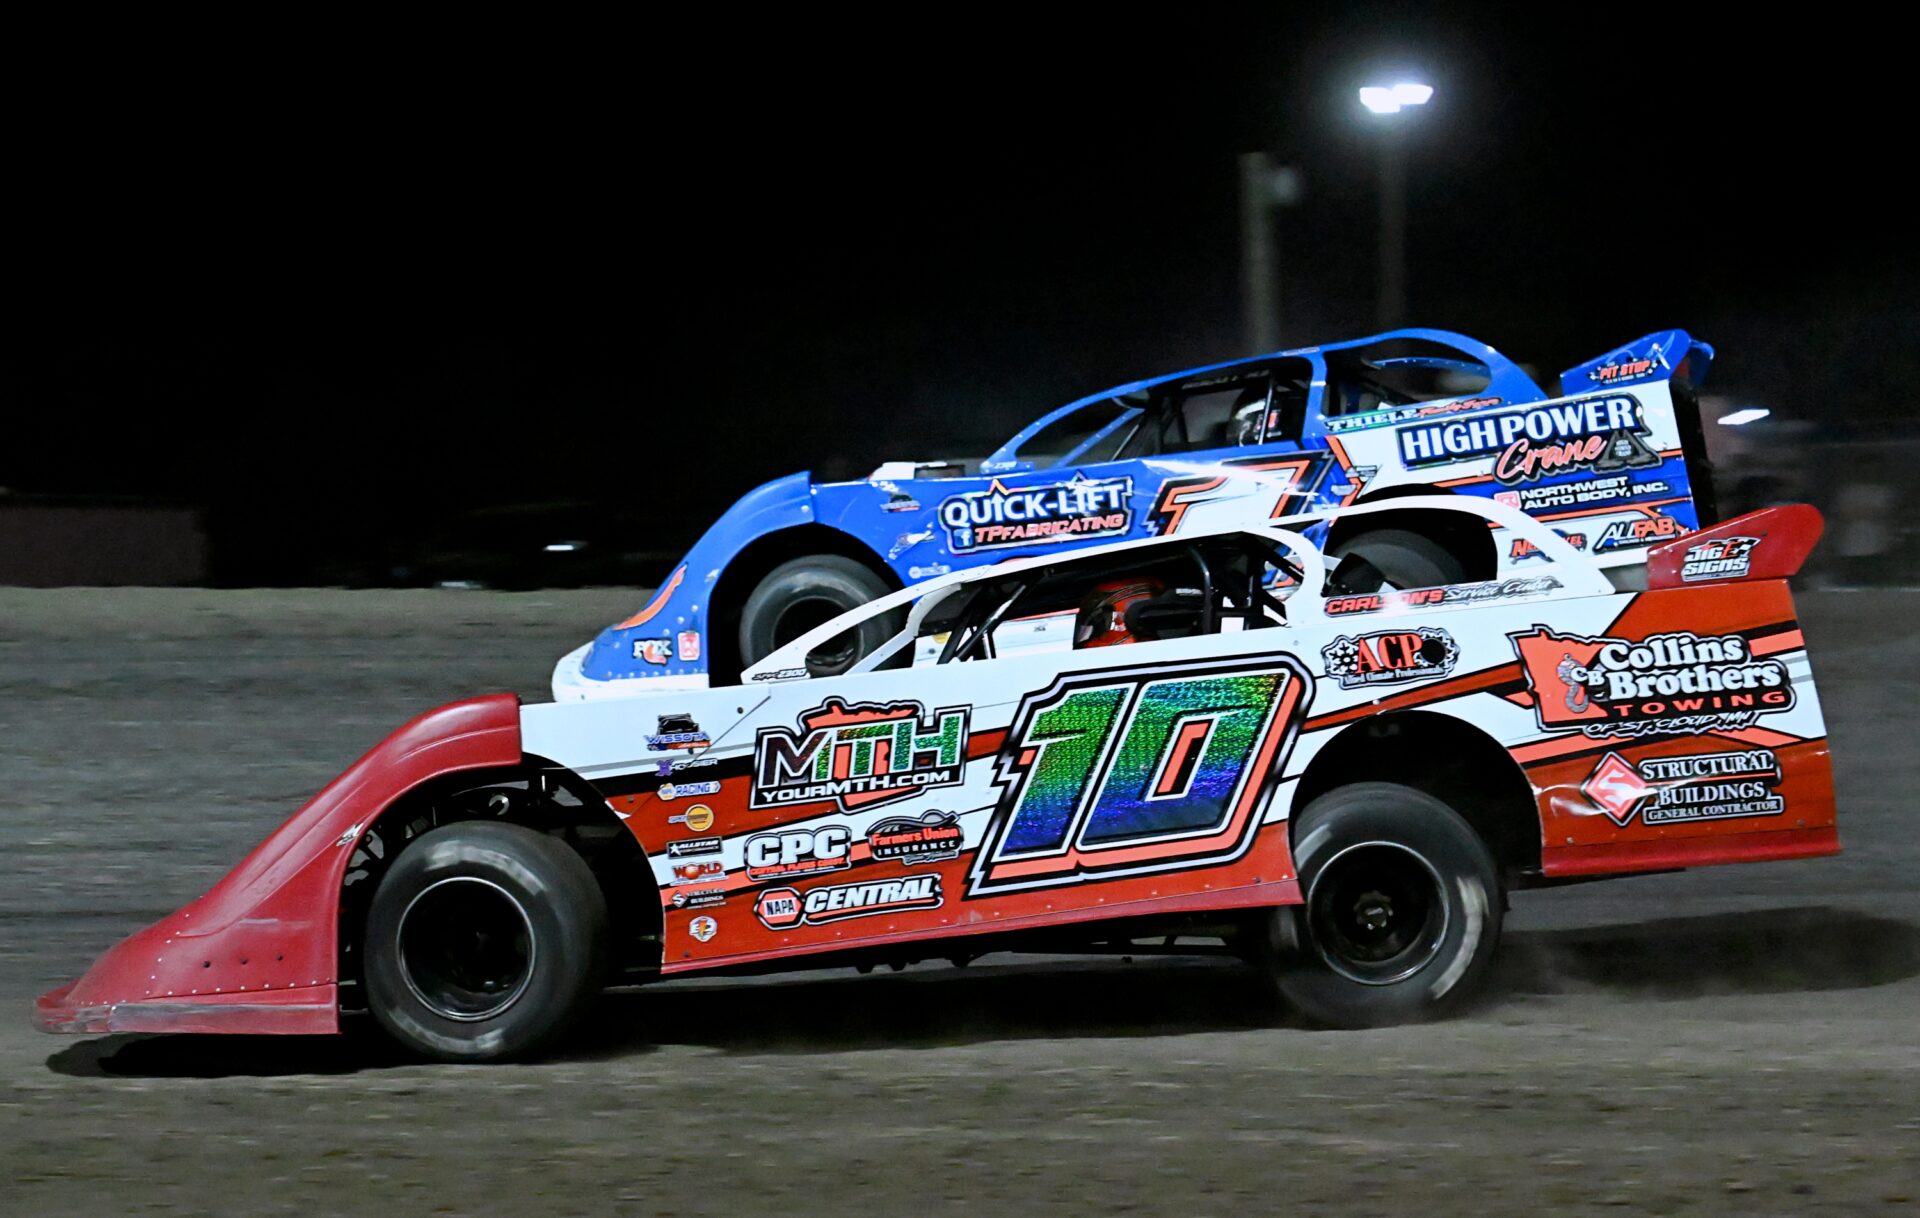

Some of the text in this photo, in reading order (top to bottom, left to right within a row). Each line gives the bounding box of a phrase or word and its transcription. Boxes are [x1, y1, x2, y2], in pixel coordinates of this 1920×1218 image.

[1600, 364, 1620, 380] PIT
[1326, 408, 1419, 432] THIELE
[1402, 398, 1635, 460] HIGH POWER
[1496, 434, 1607, 480] Crane
[1521, 476, 1629, 500] NORTHWEST
[1524, 493, 1576, 511] AUTO
[1577, 488, 1631, 504] BODY,
[1632, 481, 1669, 495] INC.
[943, 483, 1126, 528] QUICK-LIFT
[974, 513, 1125, 543] TPFABRICATING
[1598, 518, 1676, 549] ALLFAB
[1445, 580, 1500, 604] Service
[1356, 633, 1424, 674] ACP
[1599, 634, 1745, 671] Collins
[1606, 662, 1783, 701] Brothers
[1612, 690, 1788, 717] TOWING
[1586, 720, 1618, 734] OF
[1724, 711, 1751, 725] MN
[643, 731, 711, 745] WISSOTA
[757, 712, 965, 790] MTH
[988, 667, 1302, 878] 10
[1641, 754, 1774, 780] STRUCTURAL
[676, 783, 710, 796] RACING
[761, 770, 950, 802] YOURMTH.COM
[1658, 781, 1766, 806] BUILDINGS
[1648, 800, 1779, 821] GENERAL CONTRACTOR
[746, 827, 847, 868] CPC
[871, 826, 959, 847] Farmers Union
[877, 840, 957, 856] INSURANCE
[765, 877, 935, 915] NAPA CENTRAL
